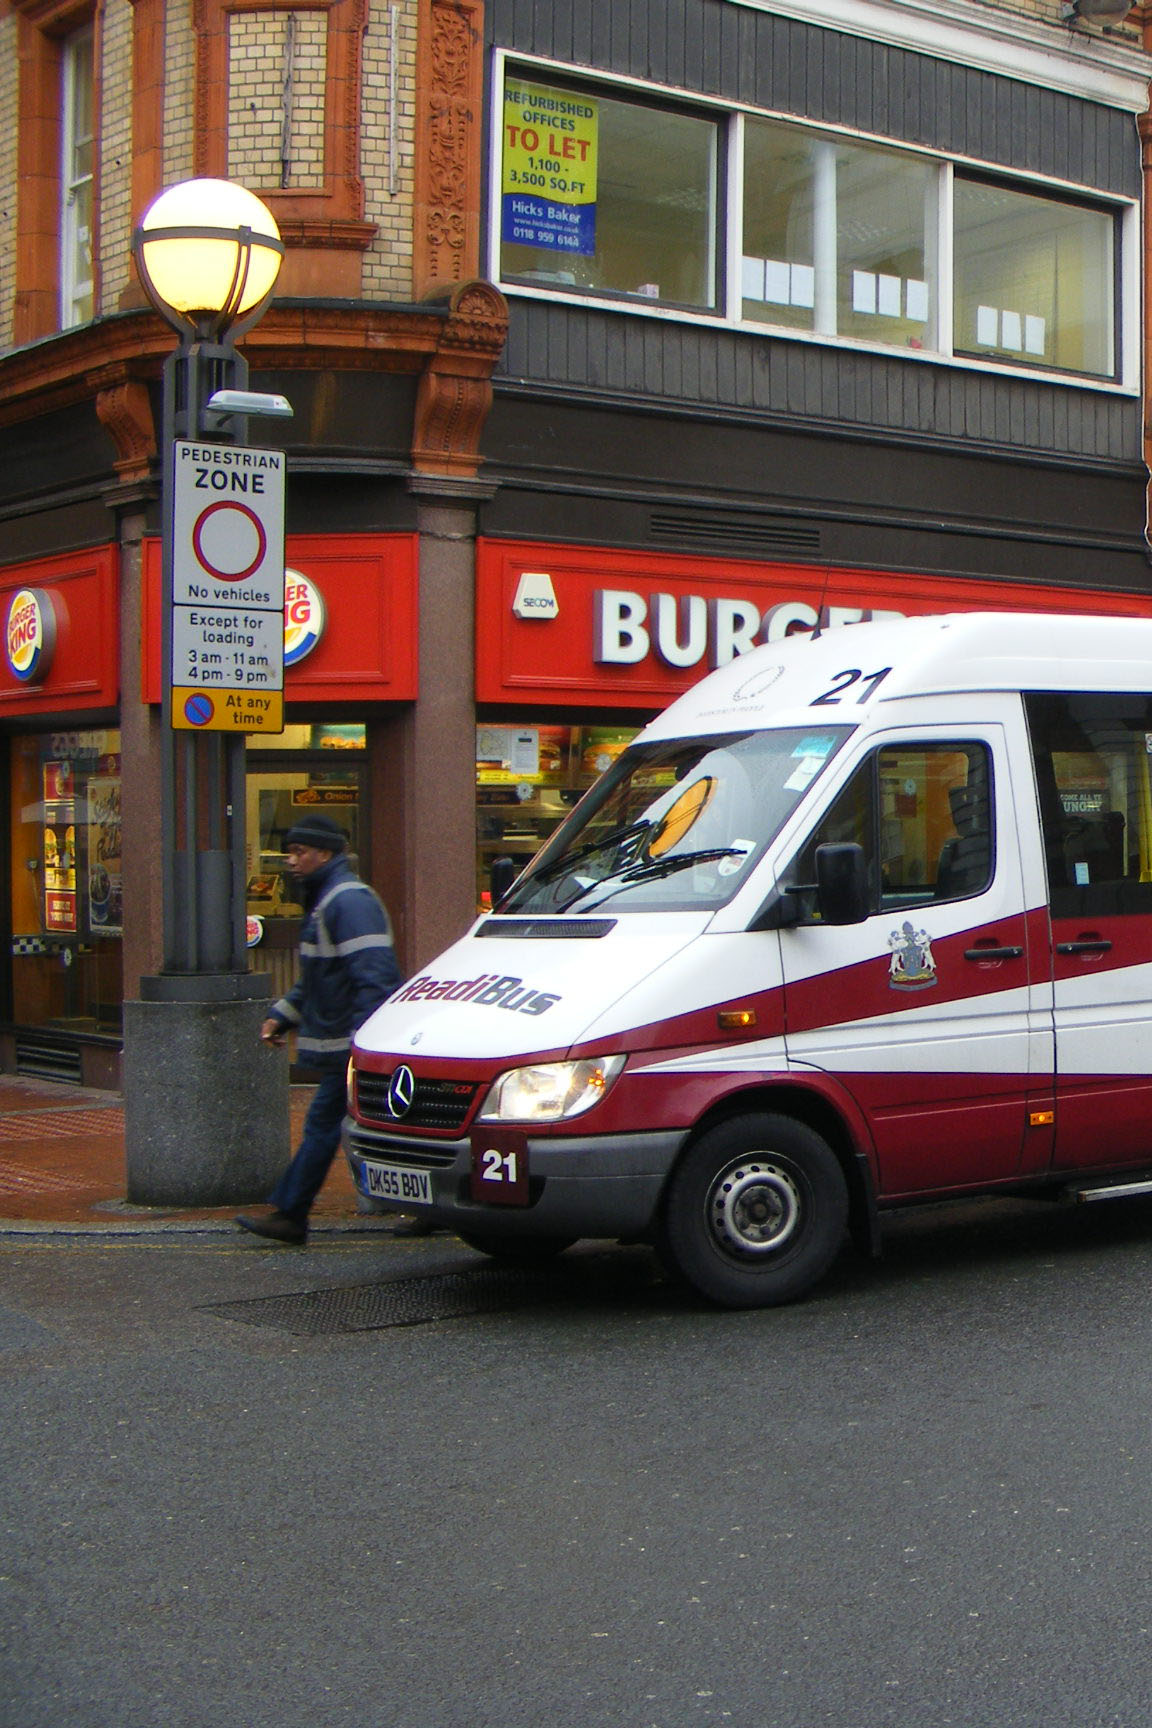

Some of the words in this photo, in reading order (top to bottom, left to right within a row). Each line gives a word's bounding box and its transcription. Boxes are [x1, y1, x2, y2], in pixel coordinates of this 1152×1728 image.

[505, 90, 593, 119] REFURBISHED
[522, 110, 576, 132] OFFICES
[506, 125, 539, 152] TO
[548, 133, 591, 162] LET
[528, 157, 561, 174] 1,100
[509, 169, 546, 188] 3,500
[550, 178, 585, 194] SQ.FT
[511, 200, 544, 217] Hicks
[547, 206, 581, 225] Baker
[513, 227, 535, 240] 0118
[537, 230, 555, 243] 959
[181, 447, 280, 470] PEDESTRIAN
[195, 467, 265, 494] ZONE
[188, 584, 208, 599] No
[214, 587, 270, 603] vehicles
[523, 597, 555, 608] SECOM
[190, 613, 239, 629] Except
[243, 616, 264, 630] for
[594, 588, 907, 669] BURG
[11, 617, 37, 655] KING
[203, 630, 254, 648] loading
[188, 650, 198, 663] 3
[201, 653, 222, 664] am
[233, 652, 245, 665] 11
[249, 656, 269, 667] am
[188, 666, 198, 679] 4
[202, 670, 223, 682] pm
[234, 668, 244, 681] 9
[246, 672, 268, 683] pm
[808, 667, 893, 706] 21
[226, 695, 242, 707] At
[247, 697, 271, 711] any
[233, 711, 263, 725] time
[389, 974, 563, 1016] ReadiBus
[482, 1149, 518, 1182] 21
[368, 1167, 399, 1195] DK55
[400, 1173, 429, 1200] BDV
